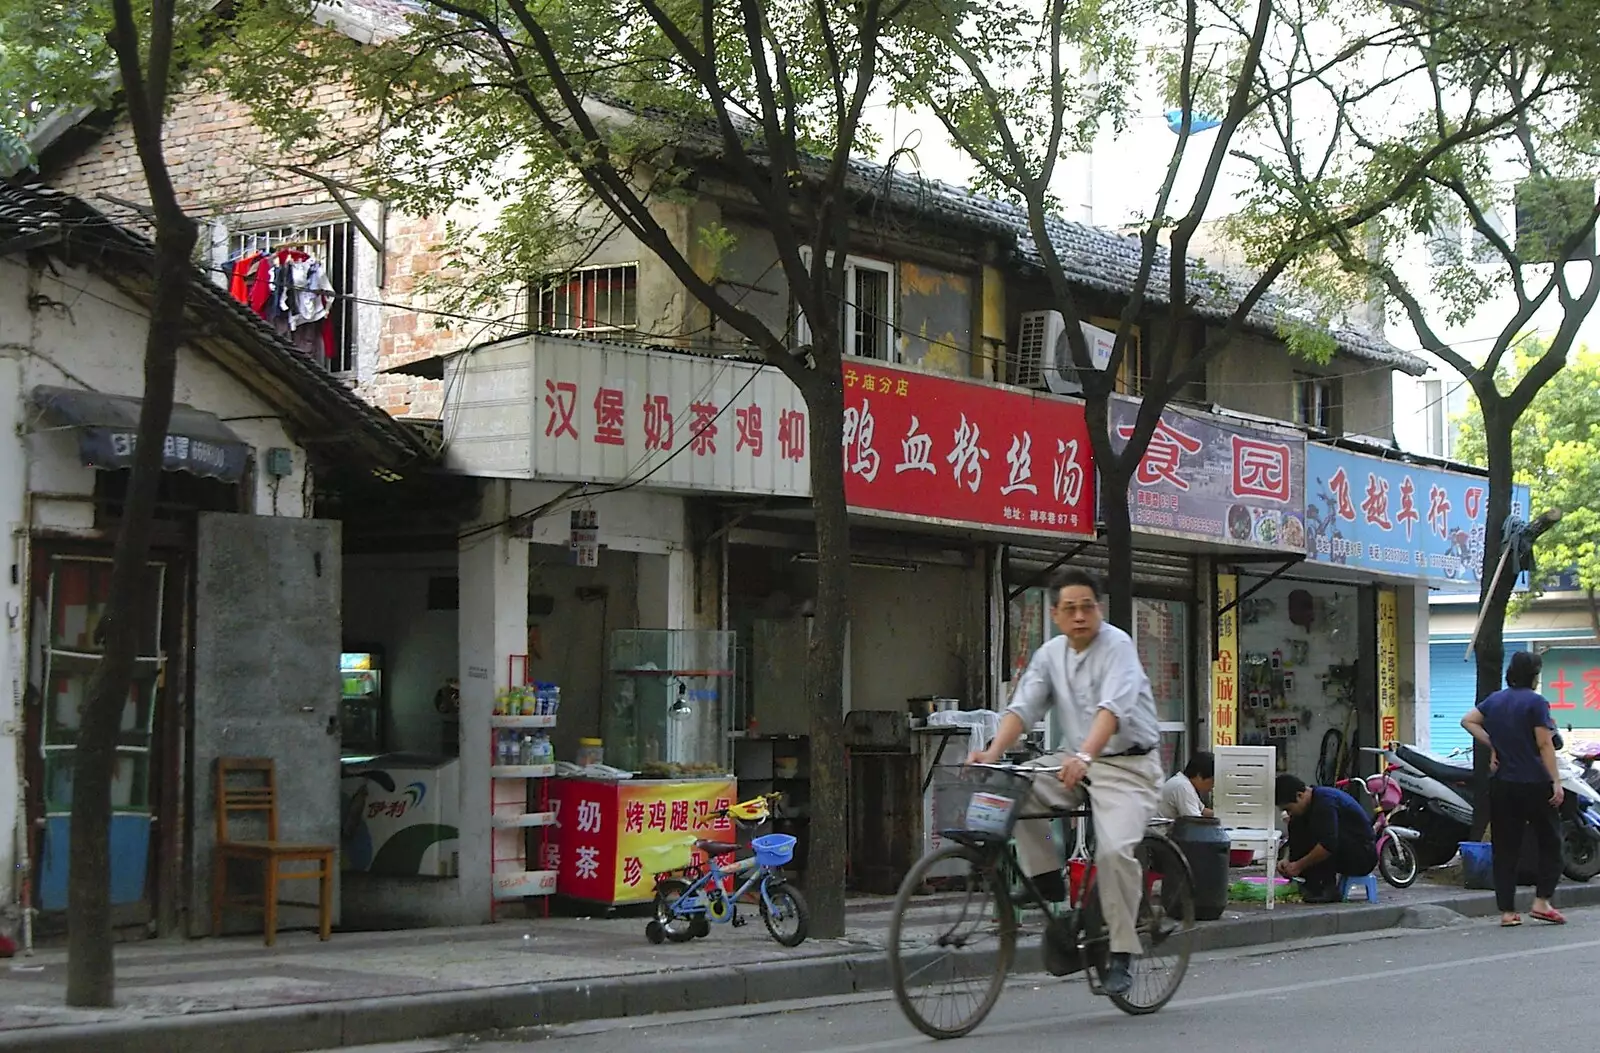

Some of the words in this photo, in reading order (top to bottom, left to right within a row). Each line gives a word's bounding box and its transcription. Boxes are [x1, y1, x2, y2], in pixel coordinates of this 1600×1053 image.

[844, 369, 909, 397] 子庙分店
[841, 398, 1084, 507] 鸭血粉丝汤
[1328, 465, 1452, 543] 飞越车行
[576, 799, 602, 879] 奶茶
[625, 799, 731, 834] 烤鸡腿汉堡
